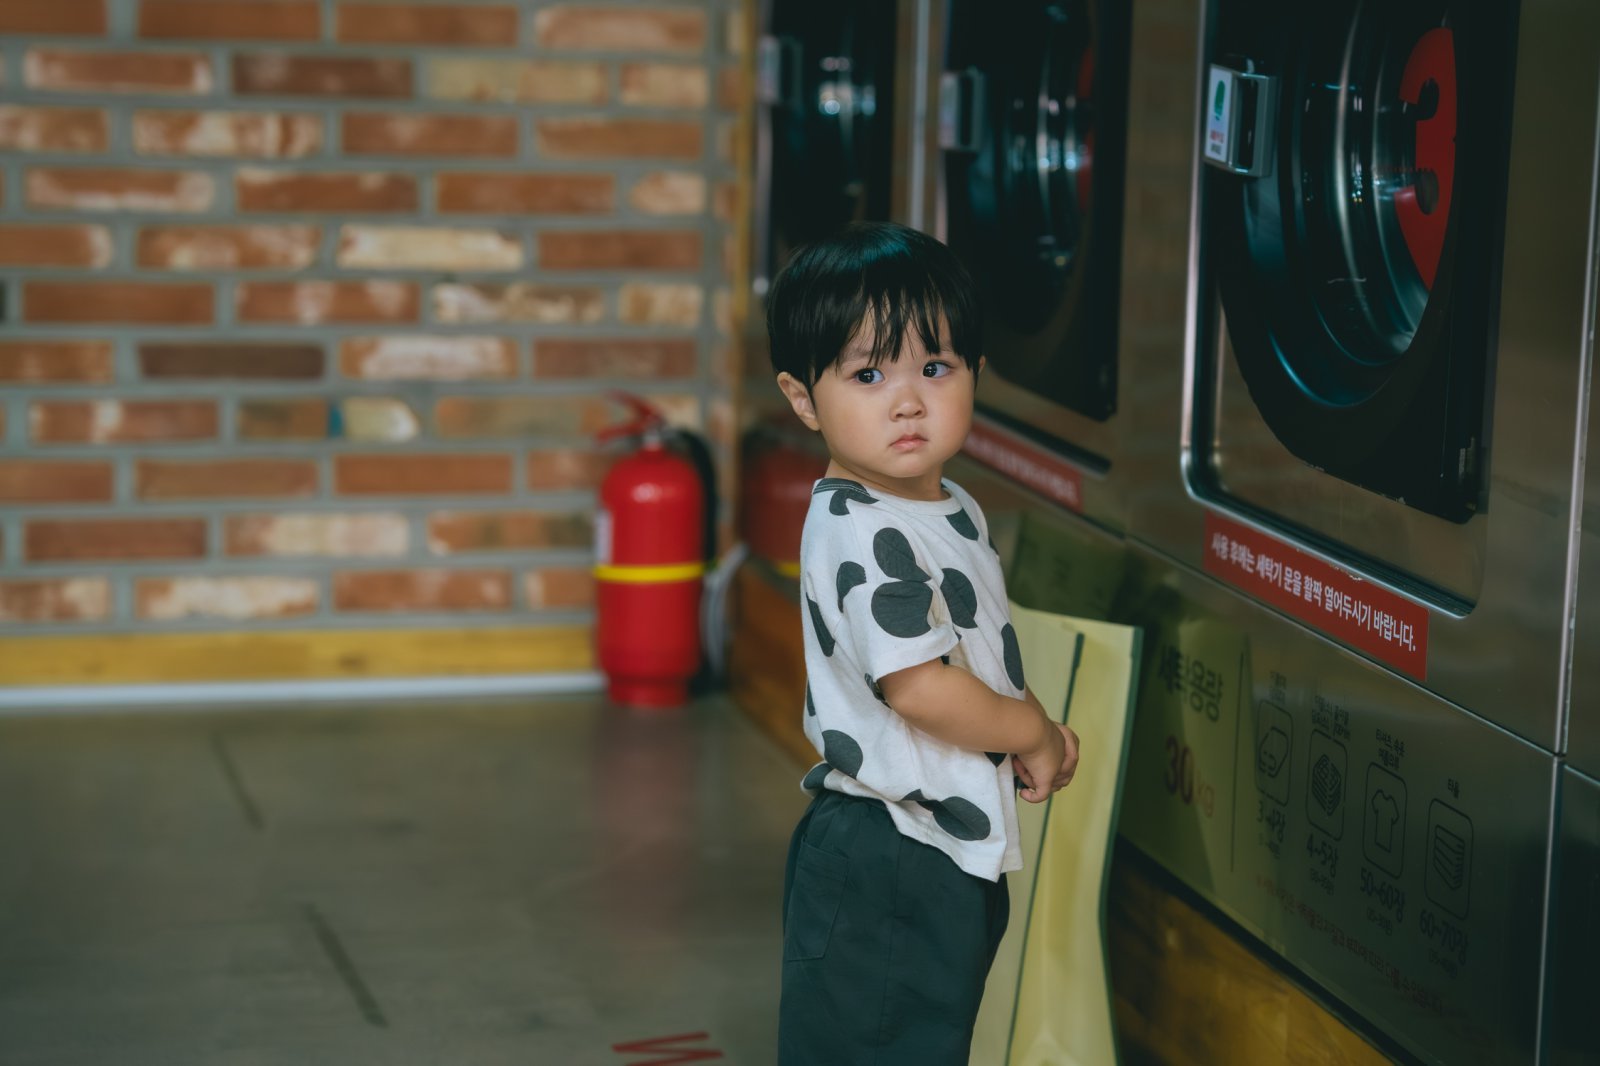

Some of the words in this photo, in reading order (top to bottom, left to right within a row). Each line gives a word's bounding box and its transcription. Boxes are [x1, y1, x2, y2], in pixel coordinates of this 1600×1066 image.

[1393, 26, 1458, 291] 3
[1211, 531, 1229, 560] 사용
[1229, 541, 1256, 574] 후에는
[1255, 553, 1282, 588] 세탁기
[1283, 566, 1303, 597] 문을
[1303, 575, 1323, 607] 활짝
[1324, 585, 1372, 631] 열어두시기
[1373, 610, 1417, 652] 바랍니다.
[1159, 644, 1223, 723] 세탁용량
[1306, 832, 1340, 878] 4~5장
[1359, 867, 1406, 923] 50~60장
[1419, 908, 1470, 965] 60~70장
